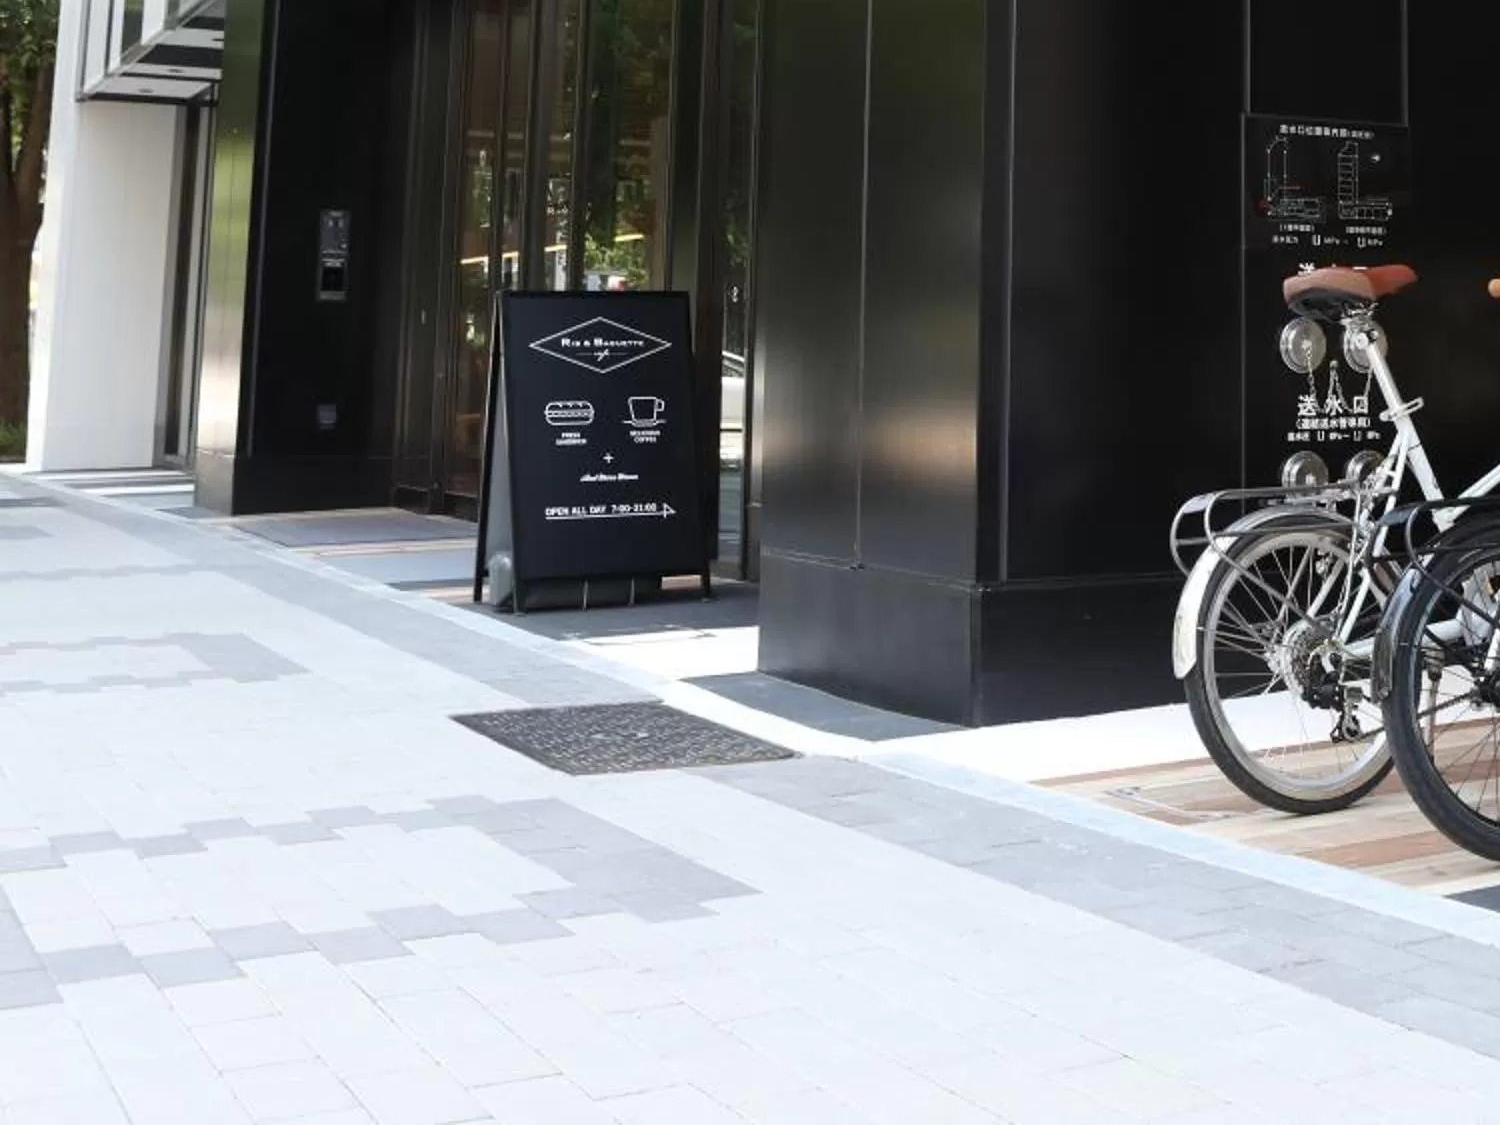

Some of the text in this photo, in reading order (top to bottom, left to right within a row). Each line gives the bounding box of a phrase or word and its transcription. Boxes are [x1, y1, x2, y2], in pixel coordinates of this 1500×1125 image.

[1297, 394, 1369, 416] 送水口
[545, 507, 569, 516] OPEN
[571, 506, 587, 515] ALL
[589, 504, 607, 514] DAY
